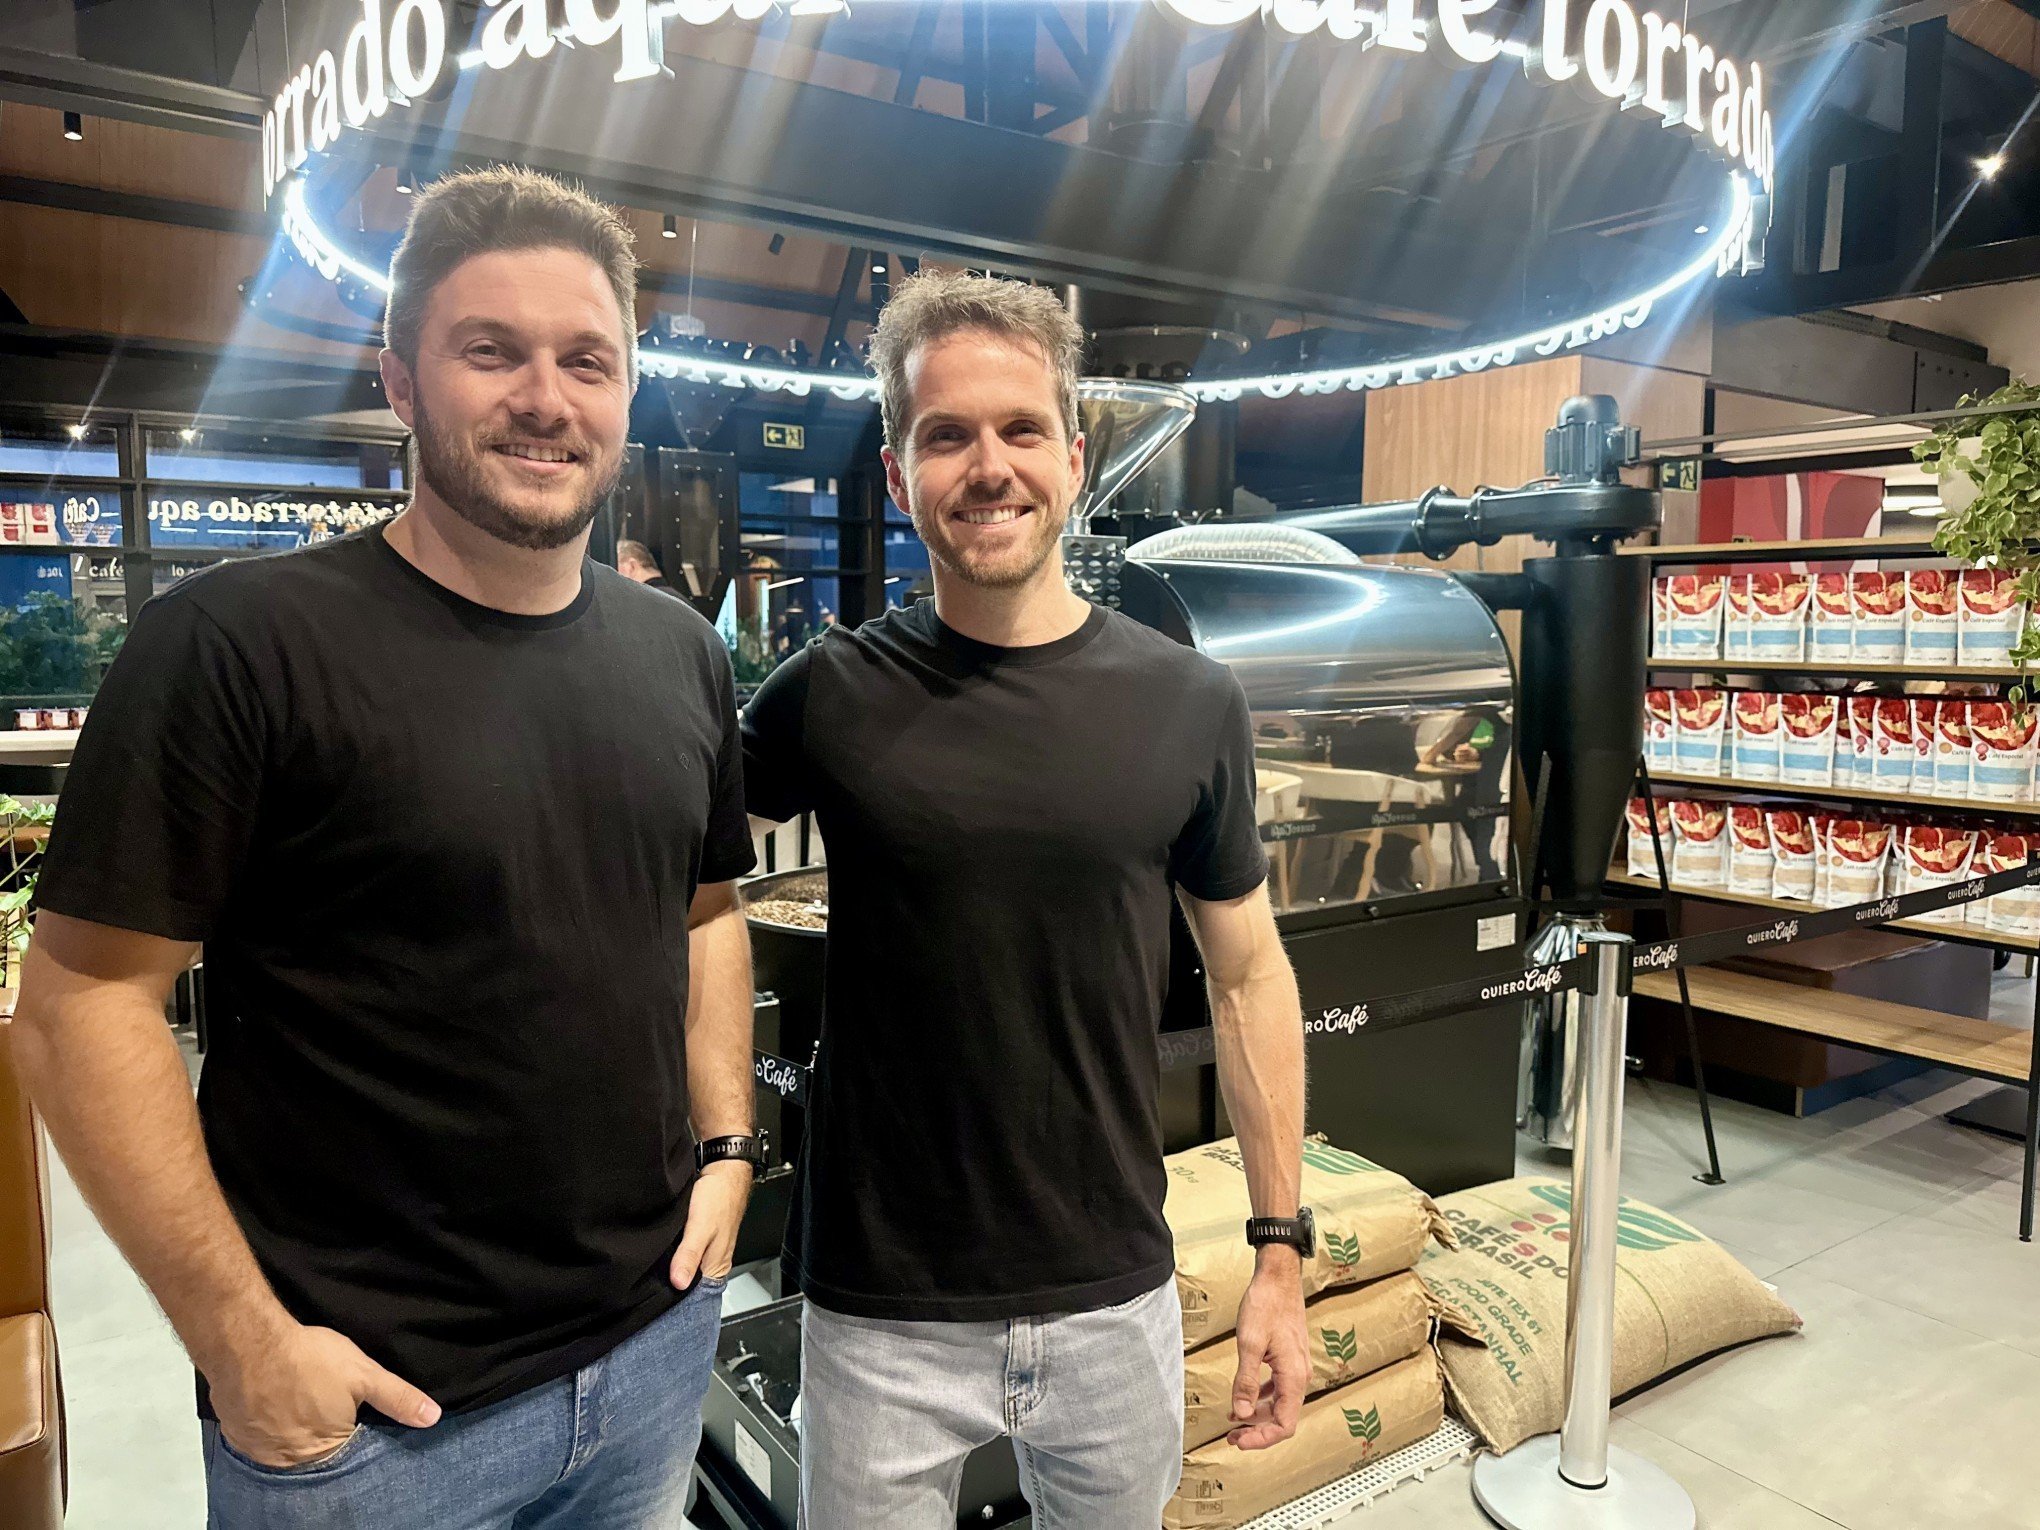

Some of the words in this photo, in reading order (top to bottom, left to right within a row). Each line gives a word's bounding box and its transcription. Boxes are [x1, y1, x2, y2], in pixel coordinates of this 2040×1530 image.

[1967, 879, 1986, 899] Café
[1855, 909, 1880, 922] QUIERO
[1879, 898, 1899, 919] Café
[1747, 930, 1775, 945] QUIERO
[1774, 919, 1799, 941] Café
[1633, 955, 1651, 968] ERO
[1650, 944, 1679, 967] Café
[1481, 981, 1525, 1000] QUIERO
[1524, 964, 1562, 992] Café
[1323, 1004, 1368, 1034] Café
[762, 1056, 798, 1096] Café
[1449, 1277, 1489, 1304] FOOD
[1488, 1305, 1534, 1356] GRADE
[1507, 1296, 1532, 1322] TEX
